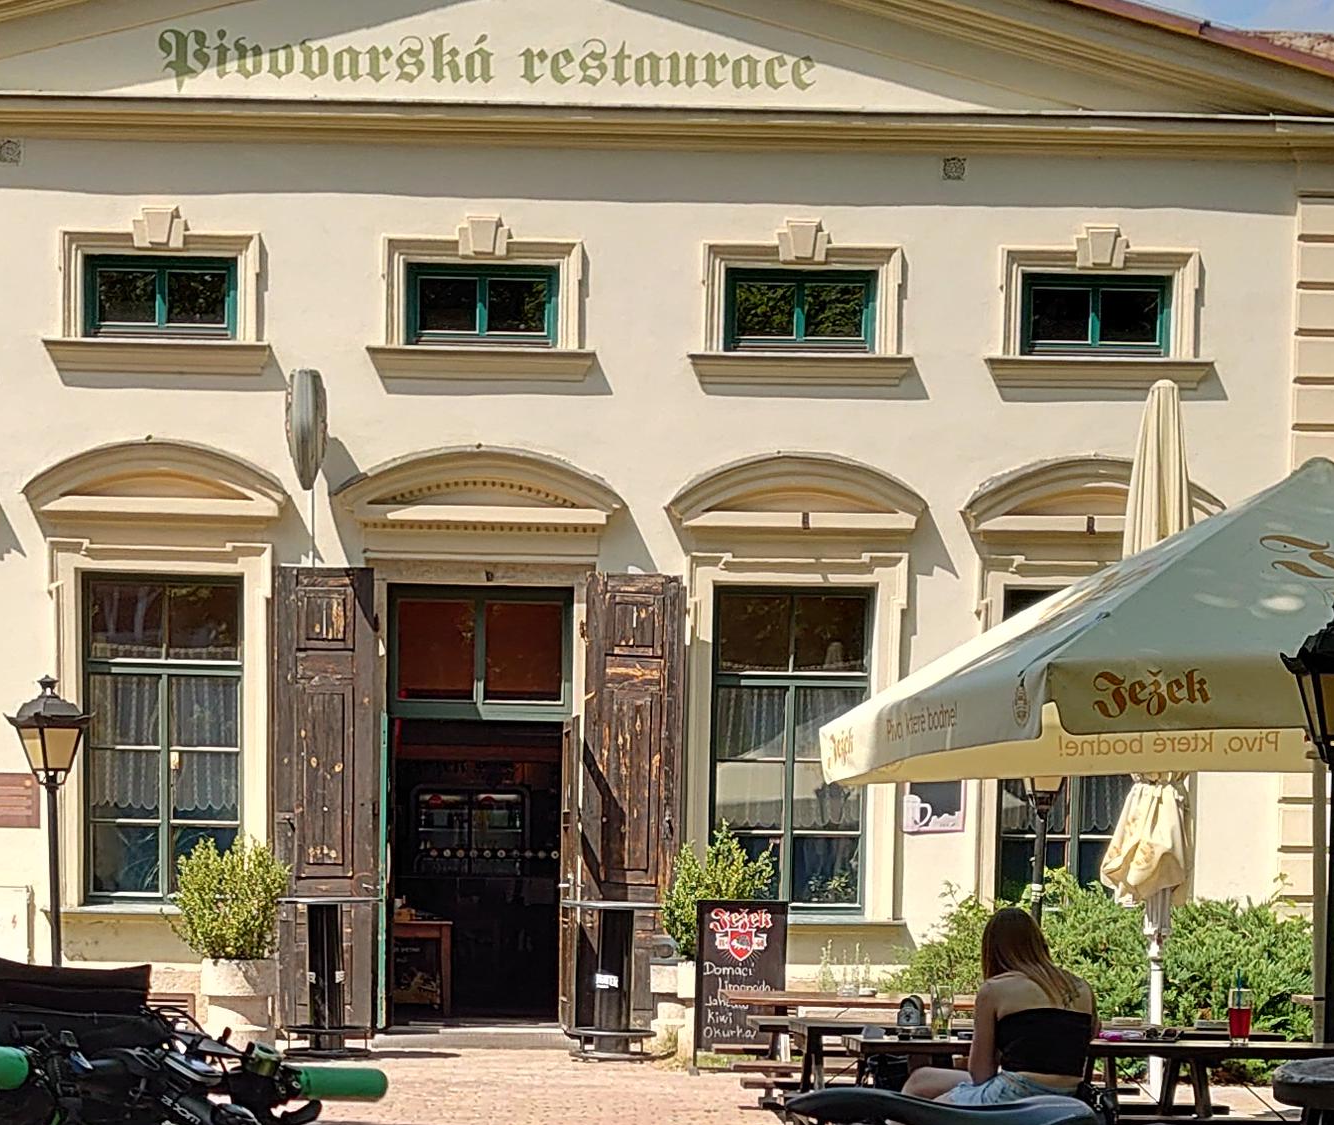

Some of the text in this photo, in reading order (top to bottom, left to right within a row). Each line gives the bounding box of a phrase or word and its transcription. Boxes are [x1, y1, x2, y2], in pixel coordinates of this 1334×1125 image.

[158, 29, 816, 92] Pivovarská restaurace
[1093, 669, 1211, 719] Ježek
[886, 701, 958, 742] Pivo, které bodne!
[709, 908, 773, 932] Ježek
